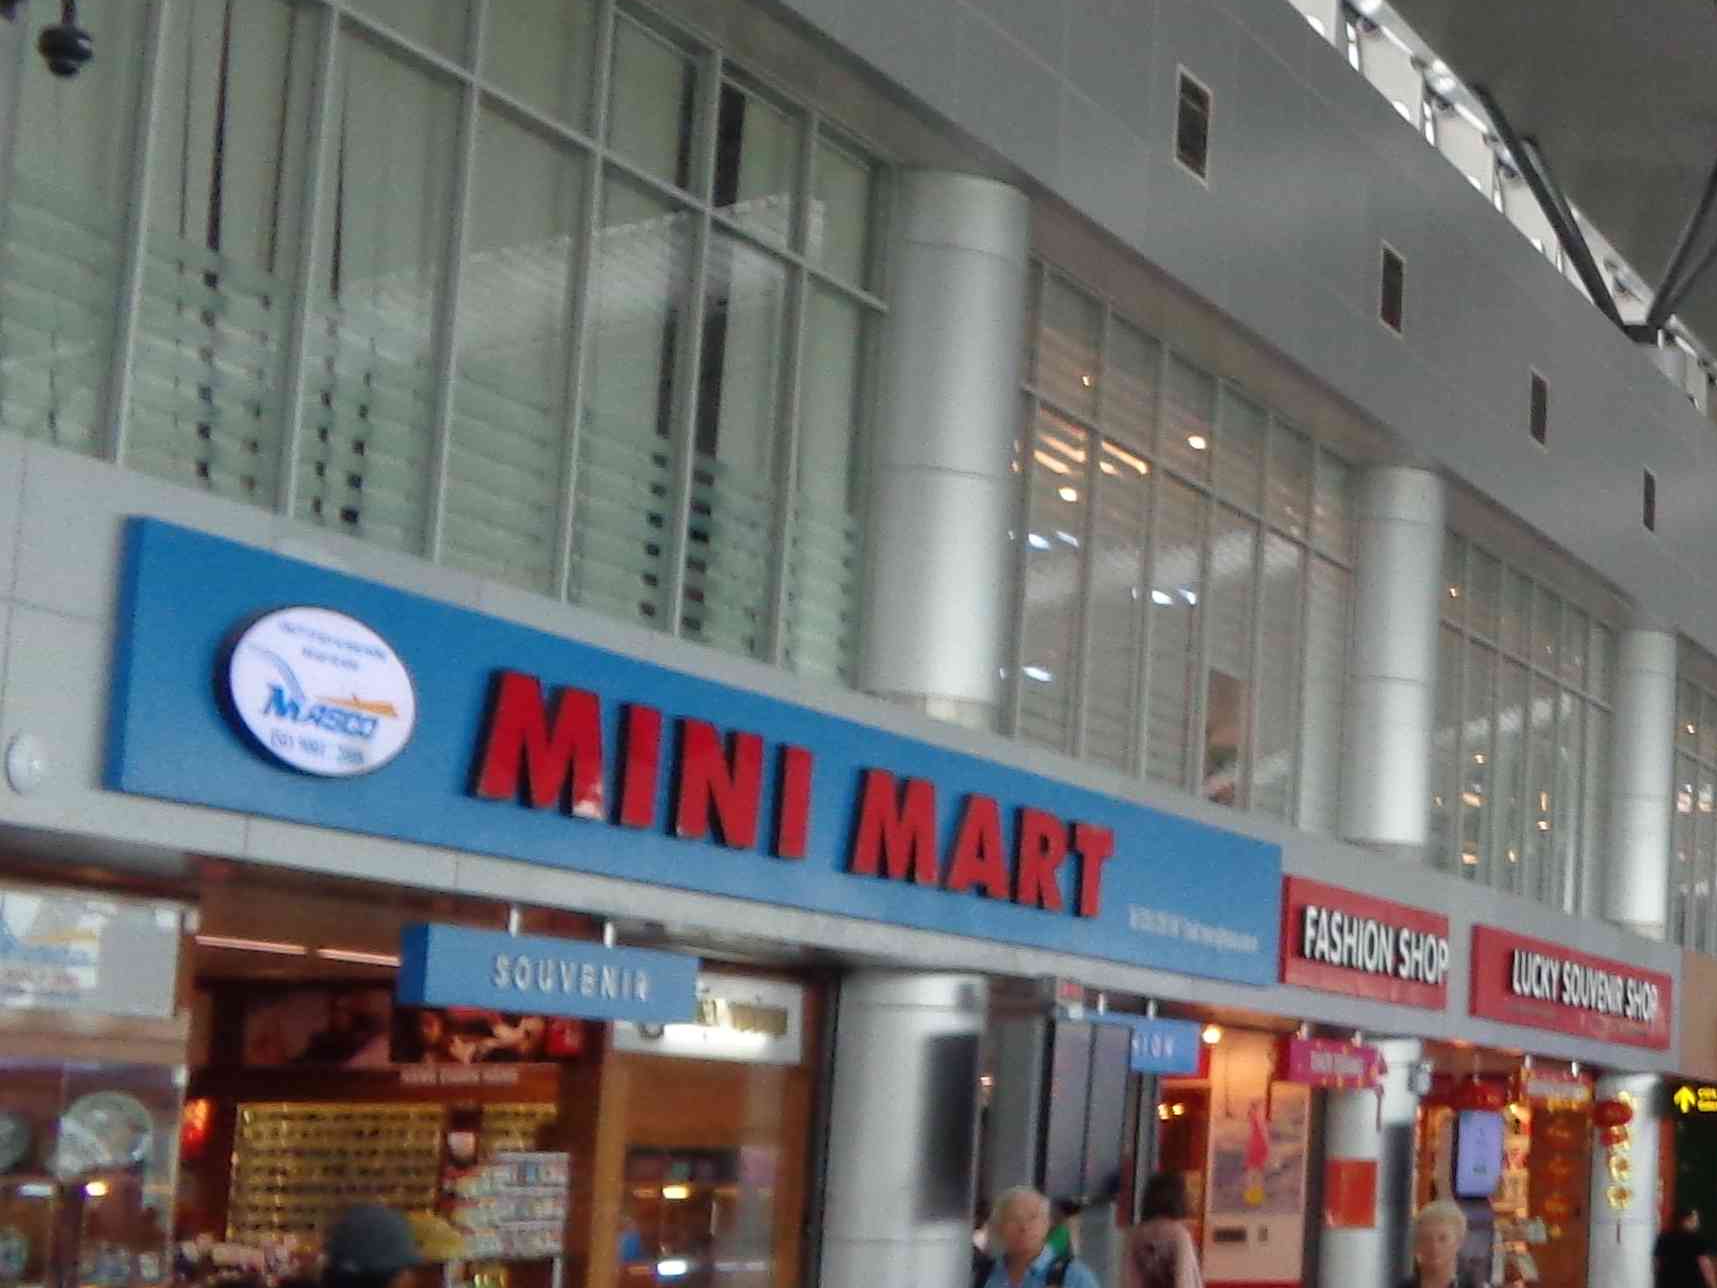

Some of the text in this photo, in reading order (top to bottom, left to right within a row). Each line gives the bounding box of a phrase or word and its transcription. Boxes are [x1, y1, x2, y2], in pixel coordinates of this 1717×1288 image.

[472, 669, 1114, 918] MINI MART
[494, 951, 649, 1001] SOUVENIR
[1304, 905, 1394, 974] FASHION
[1399, 931, 1449, 985] SHOP
[1513, 948, 1660, 1023] LUCKY SOUVENIR SHOP
